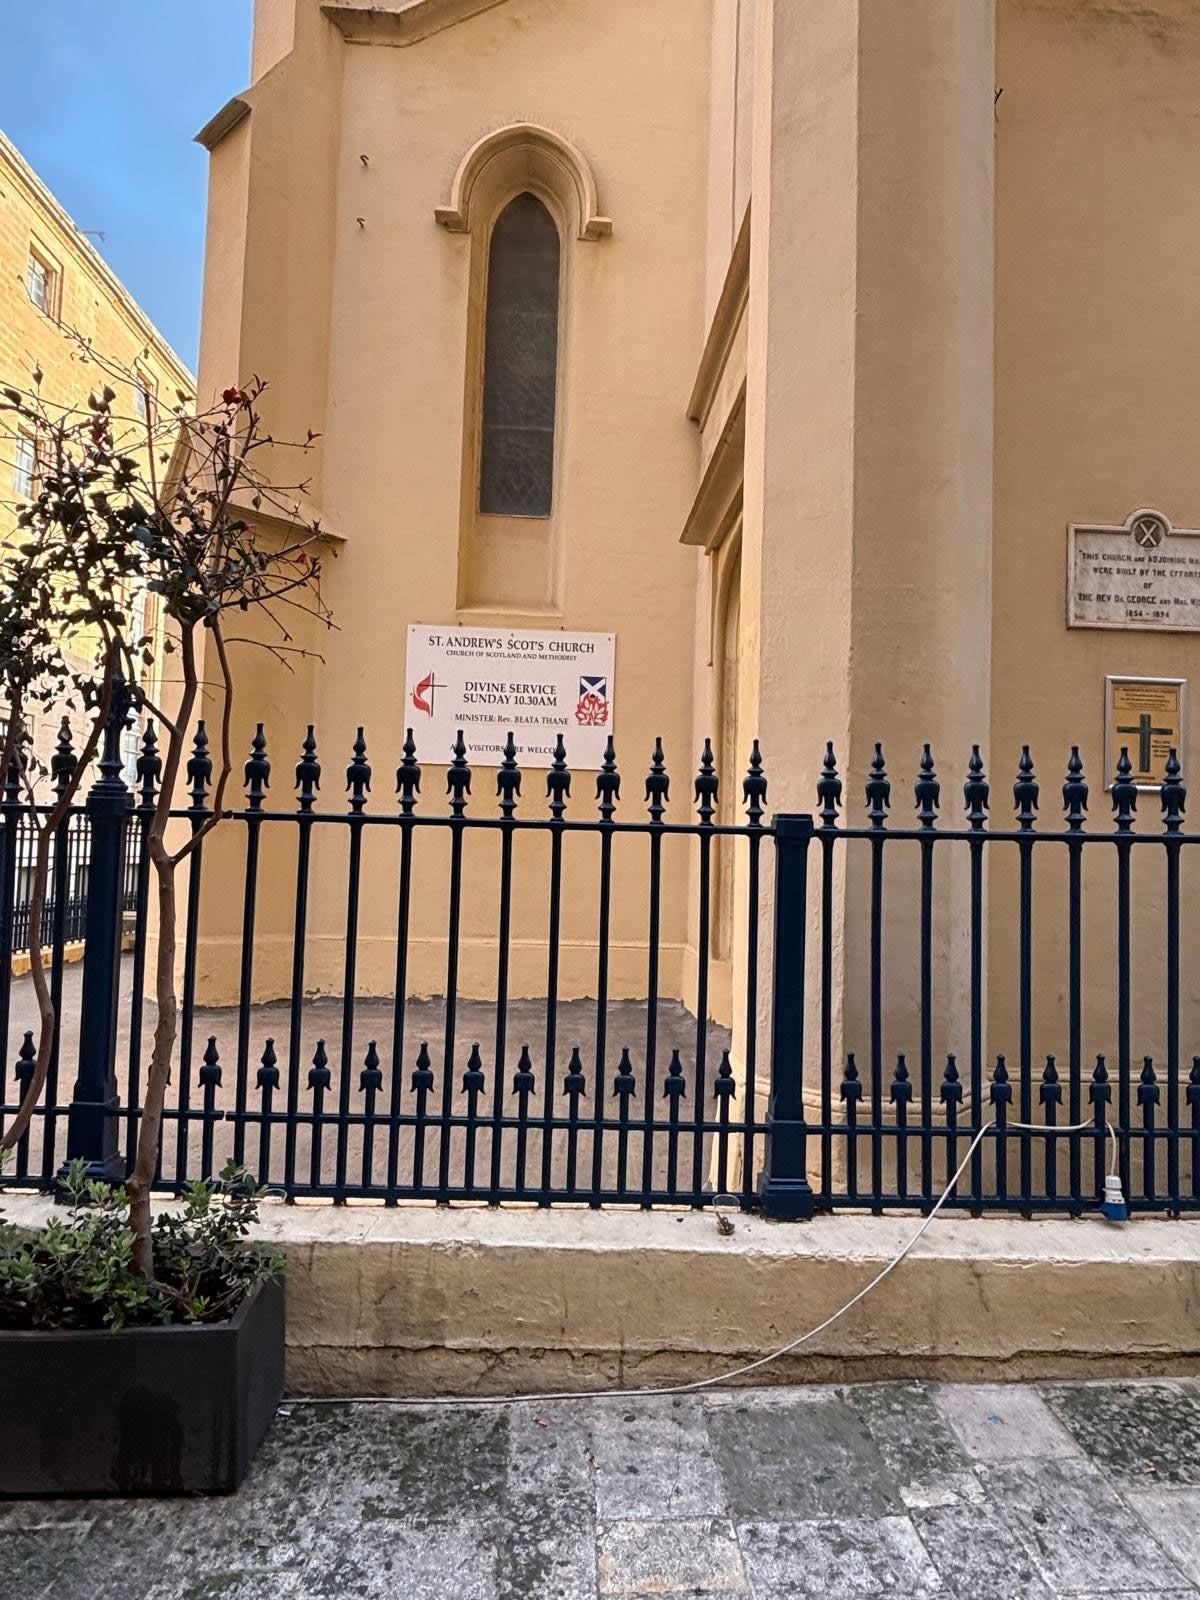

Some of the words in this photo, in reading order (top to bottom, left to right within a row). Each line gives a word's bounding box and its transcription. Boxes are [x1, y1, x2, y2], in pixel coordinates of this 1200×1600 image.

[1102, 553, 1132, 561] CHURCH
[1148, 556, 1186, 564] ADJOINING
[1189, 557, 1200, 565] MA
[1093, 566, 1113, 575] WERE
[1116, 567, 1136, 575] BUILT
[1139, 568, 1150, 577] BY
[1152, 569, 1167, 577] THE
[1143, 582, 1153, 590] OF
[1078, 592, 1093, 601] THE
[1127, 595, 1157, 605] GEORGE
[1125, 609, 1143, 617] 1854
[428, 635, 444, 647] ST.
[446, 636, 503, 650] ANDREW'S
[507, 639, 545, 652] SCOT'S
[549, 641, 595, 654] CHURCH
[446, 649, 475, 657] CHURCH
[485, 651, 521, 659] SCOTLAND
[522, 652, 538, 660] AND
[538, 653, 577, 661] METHODIST
[464, 681, 508, 693] DIVINE
[509, 683, 557, 695] SERVICE
[463, 693, 510, 705] SUNDAY
[514, 695, 557, 707] 10.30AM
[455, 713, 496, 723] MINISTER:
[497, 715, 512, 723] Rev.
[514, 715, 539, 724] BEATA
[541, 716, 569, 725] THANE
[468, 743, 504, 753] VISITORS
[527, 745, 557, 754] WELCO
